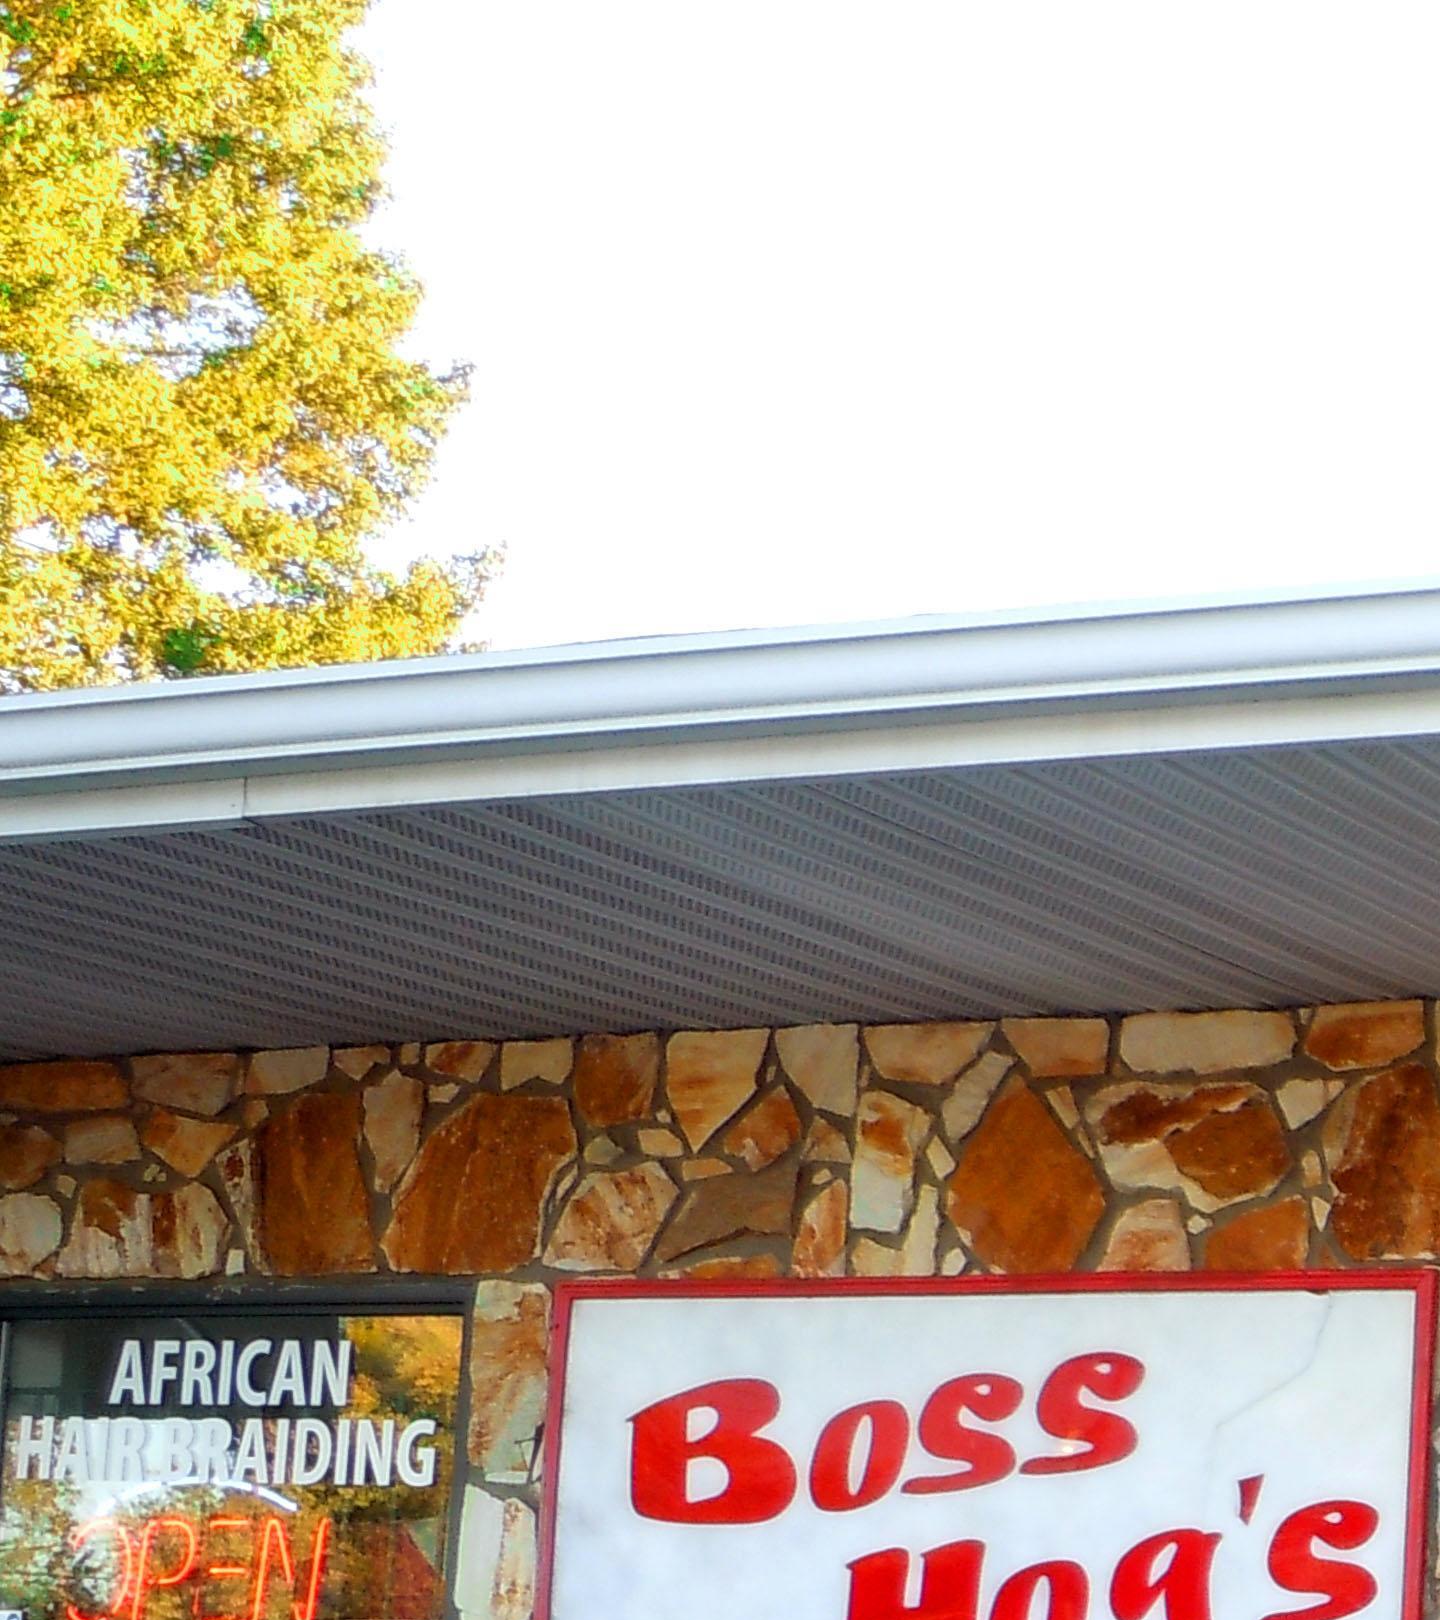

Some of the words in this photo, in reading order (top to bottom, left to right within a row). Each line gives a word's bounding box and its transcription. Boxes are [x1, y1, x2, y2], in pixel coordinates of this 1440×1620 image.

[108, 1339, 353, 1406] AFRICAN
[16, 1415, 147, 1483] HAIR
[158, 1416, 437, 1488] BRAIDING
[627, 1350, 1147, 1525] Boss
